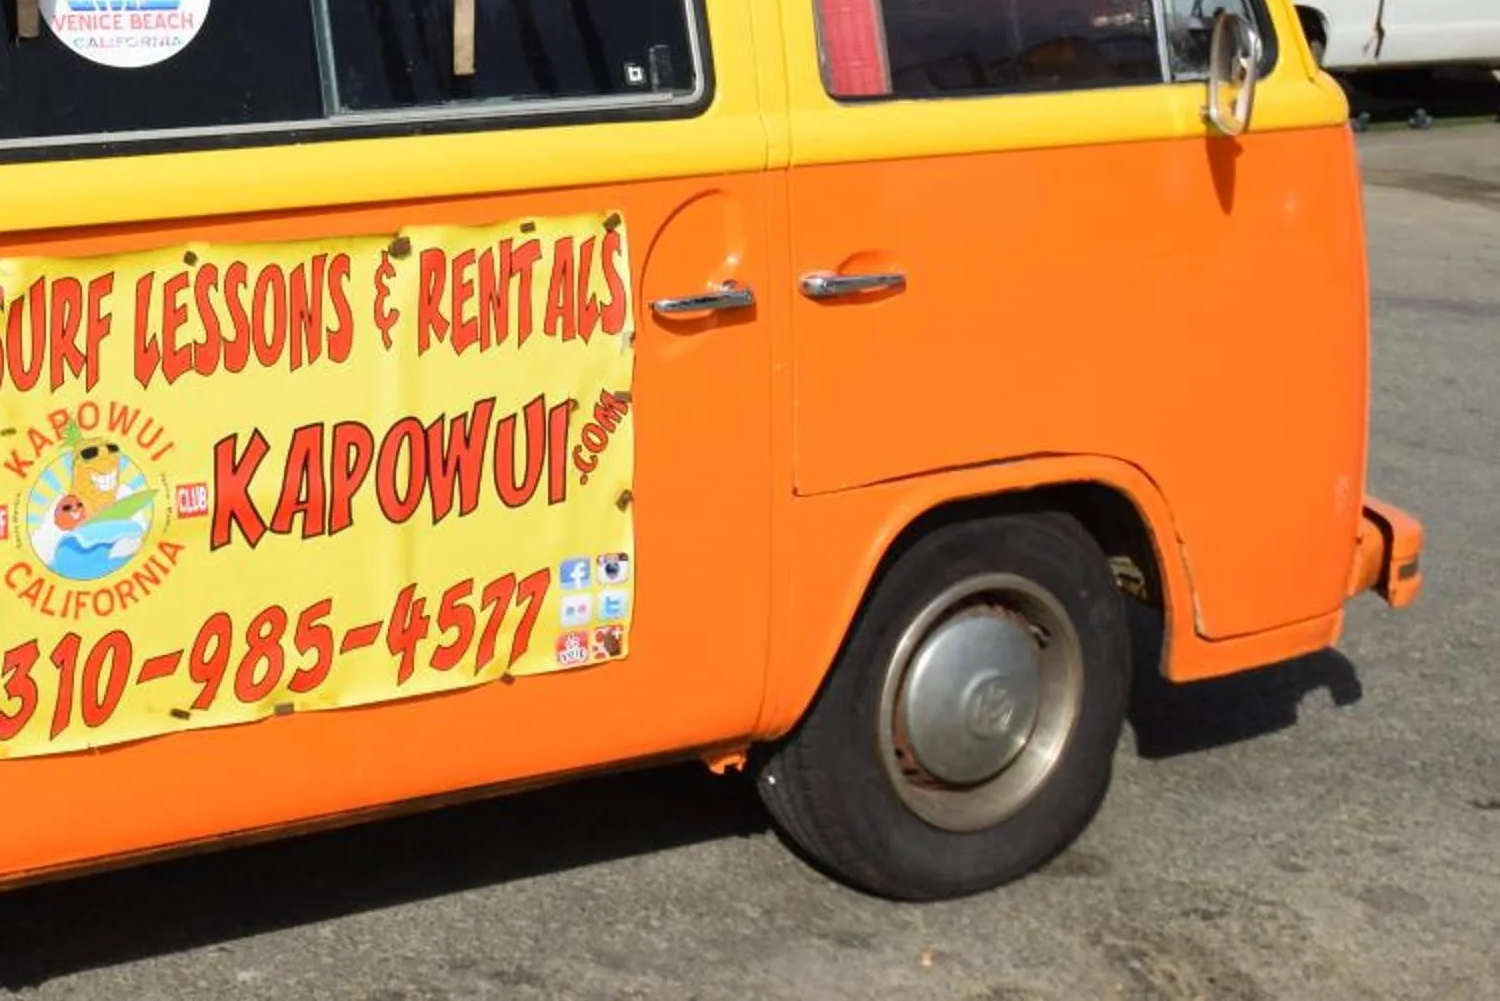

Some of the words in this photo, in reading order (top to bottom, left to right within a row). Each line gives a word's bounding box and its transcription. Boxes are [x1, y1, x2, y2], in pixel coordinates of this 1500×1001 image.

[51, 14, 124, 32] VENICE
[129, 12, 194, 31] BEACH
[73, 35, 183, 49] CALIFORNIA
[133, 251, 354, 390] LESSONS
[373, 249, 400, 351] &
[417, 228, 627, 357] RENTALS
[3, 400, 175, 479] KAPOWUI
[179, 485, 207, 513] CLUB
[3, 540, 186, 620] CALIFORNIA
